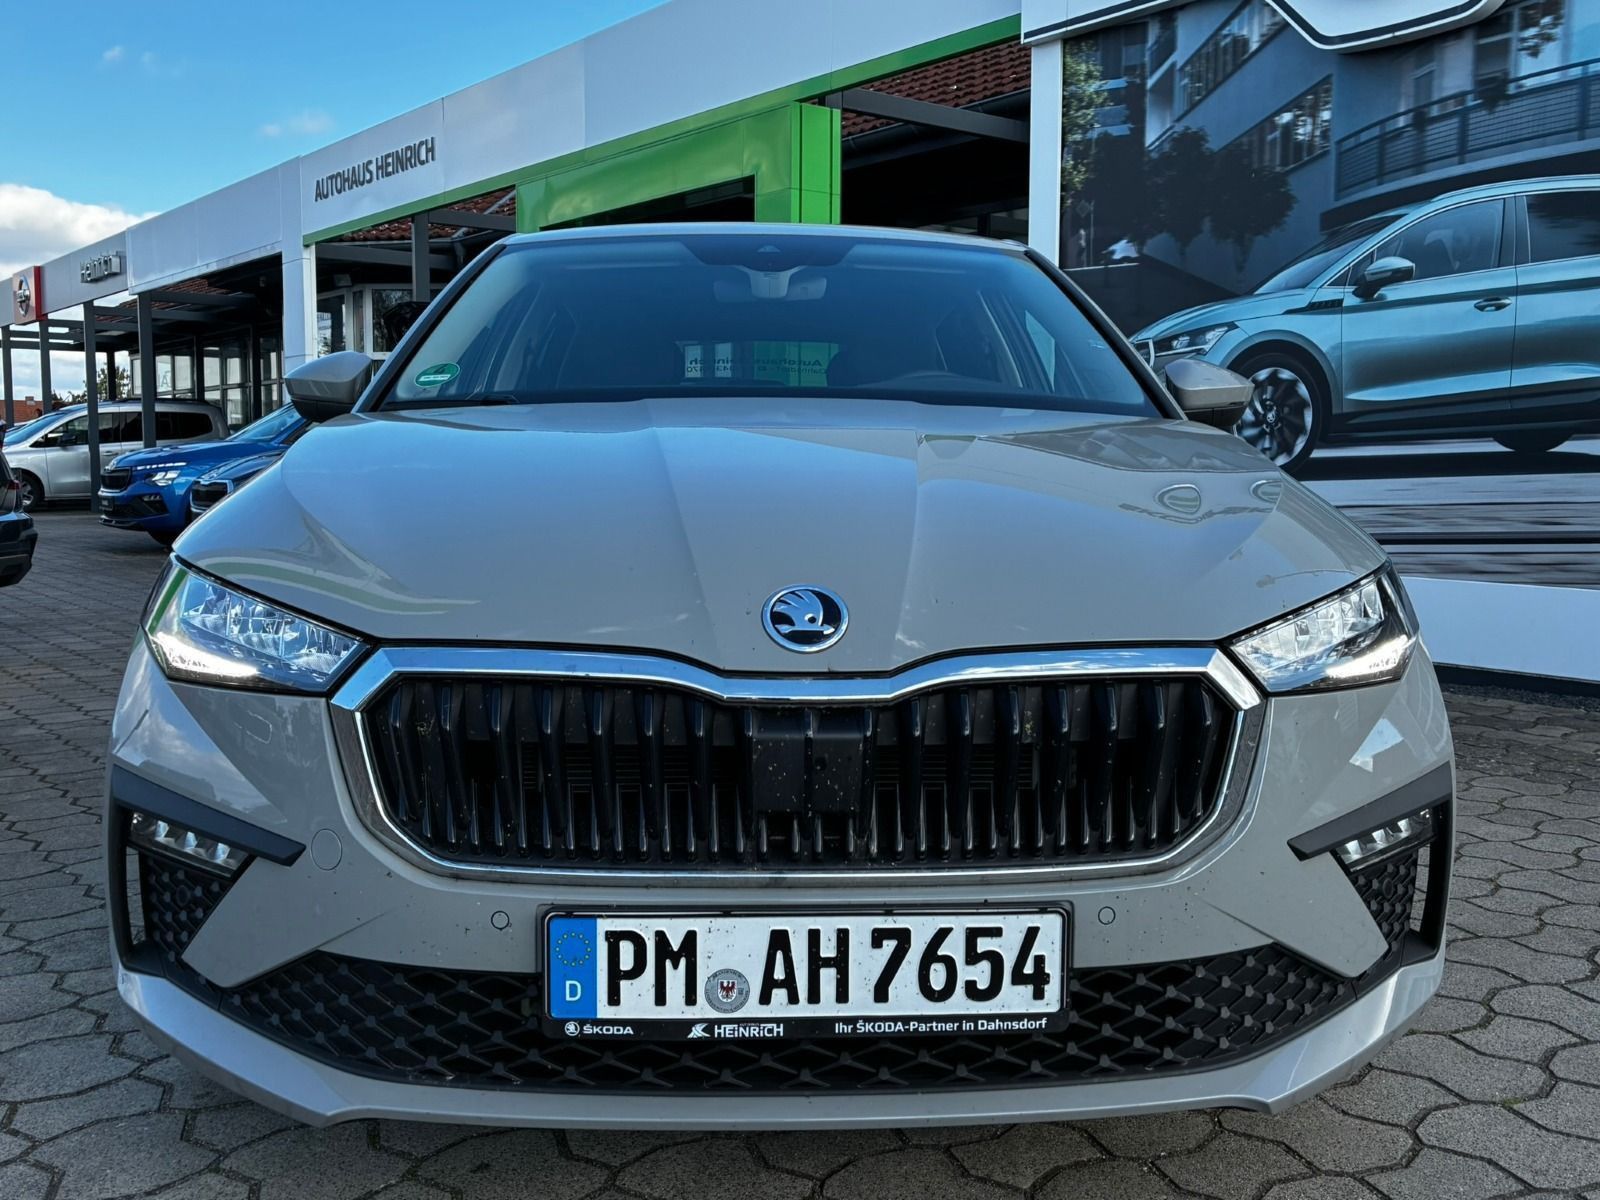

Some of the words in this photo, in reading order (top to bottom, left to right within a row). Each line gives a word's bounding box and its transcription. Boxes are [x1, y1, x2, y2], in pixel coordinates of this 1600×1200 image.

[314, 159, 373, 202] AUTOHAUS
[375, 136, 435, 181] HEINRICH
[605, 929, 698, 1007] PM
[758, 928, 850, 1006] AH
[871, 926, 1051, 1004] 7654
[565, 979, 582, 1002] D
[582, 1023, 635, 1035] ŠKODA
[834, 1021, 854, 1034] Ihr
[856, 1018, 960, 1034] ŠKODA-Partner
[961, 1018, 974, 1032] in
[977, 1017, 1048, 1031] Dahnsdorf
